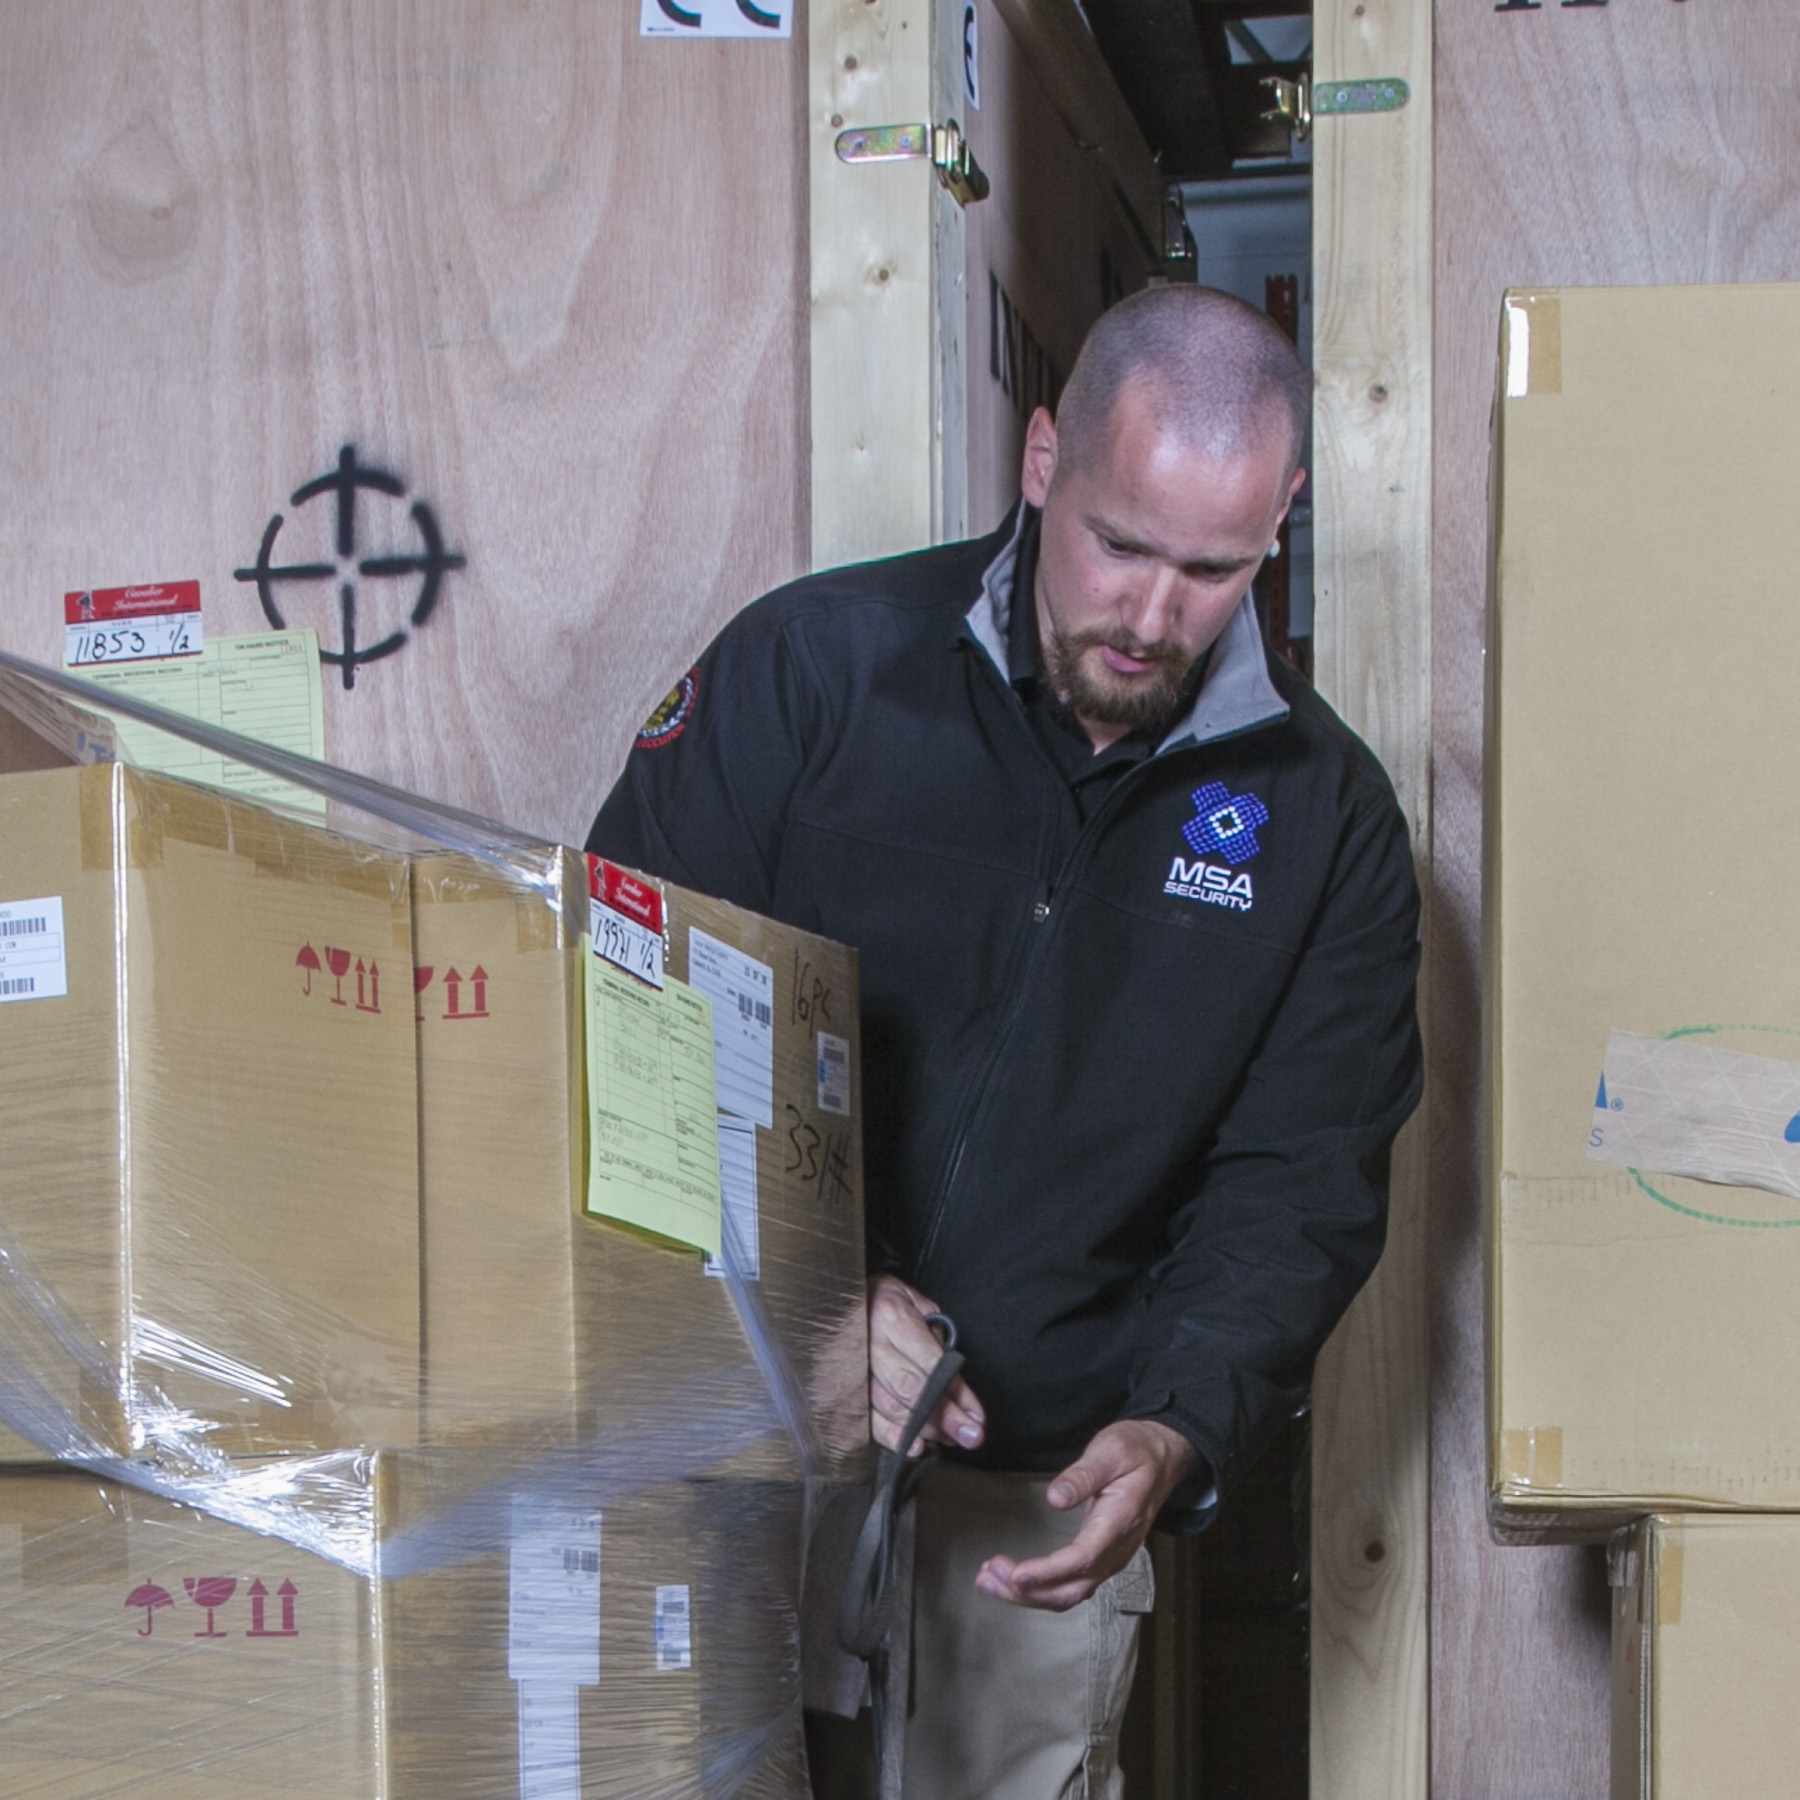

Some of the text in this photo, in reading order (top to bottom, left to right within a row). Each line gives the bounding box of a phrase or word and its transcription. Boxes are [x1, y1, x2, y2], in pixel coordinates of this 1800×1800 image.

[113, 595, 178, 610] International
[76, 632, 145, 663] 11853
[1169, 857, 1252, 898] MSA
[1163, 881, 1252, 911] SECURITY
